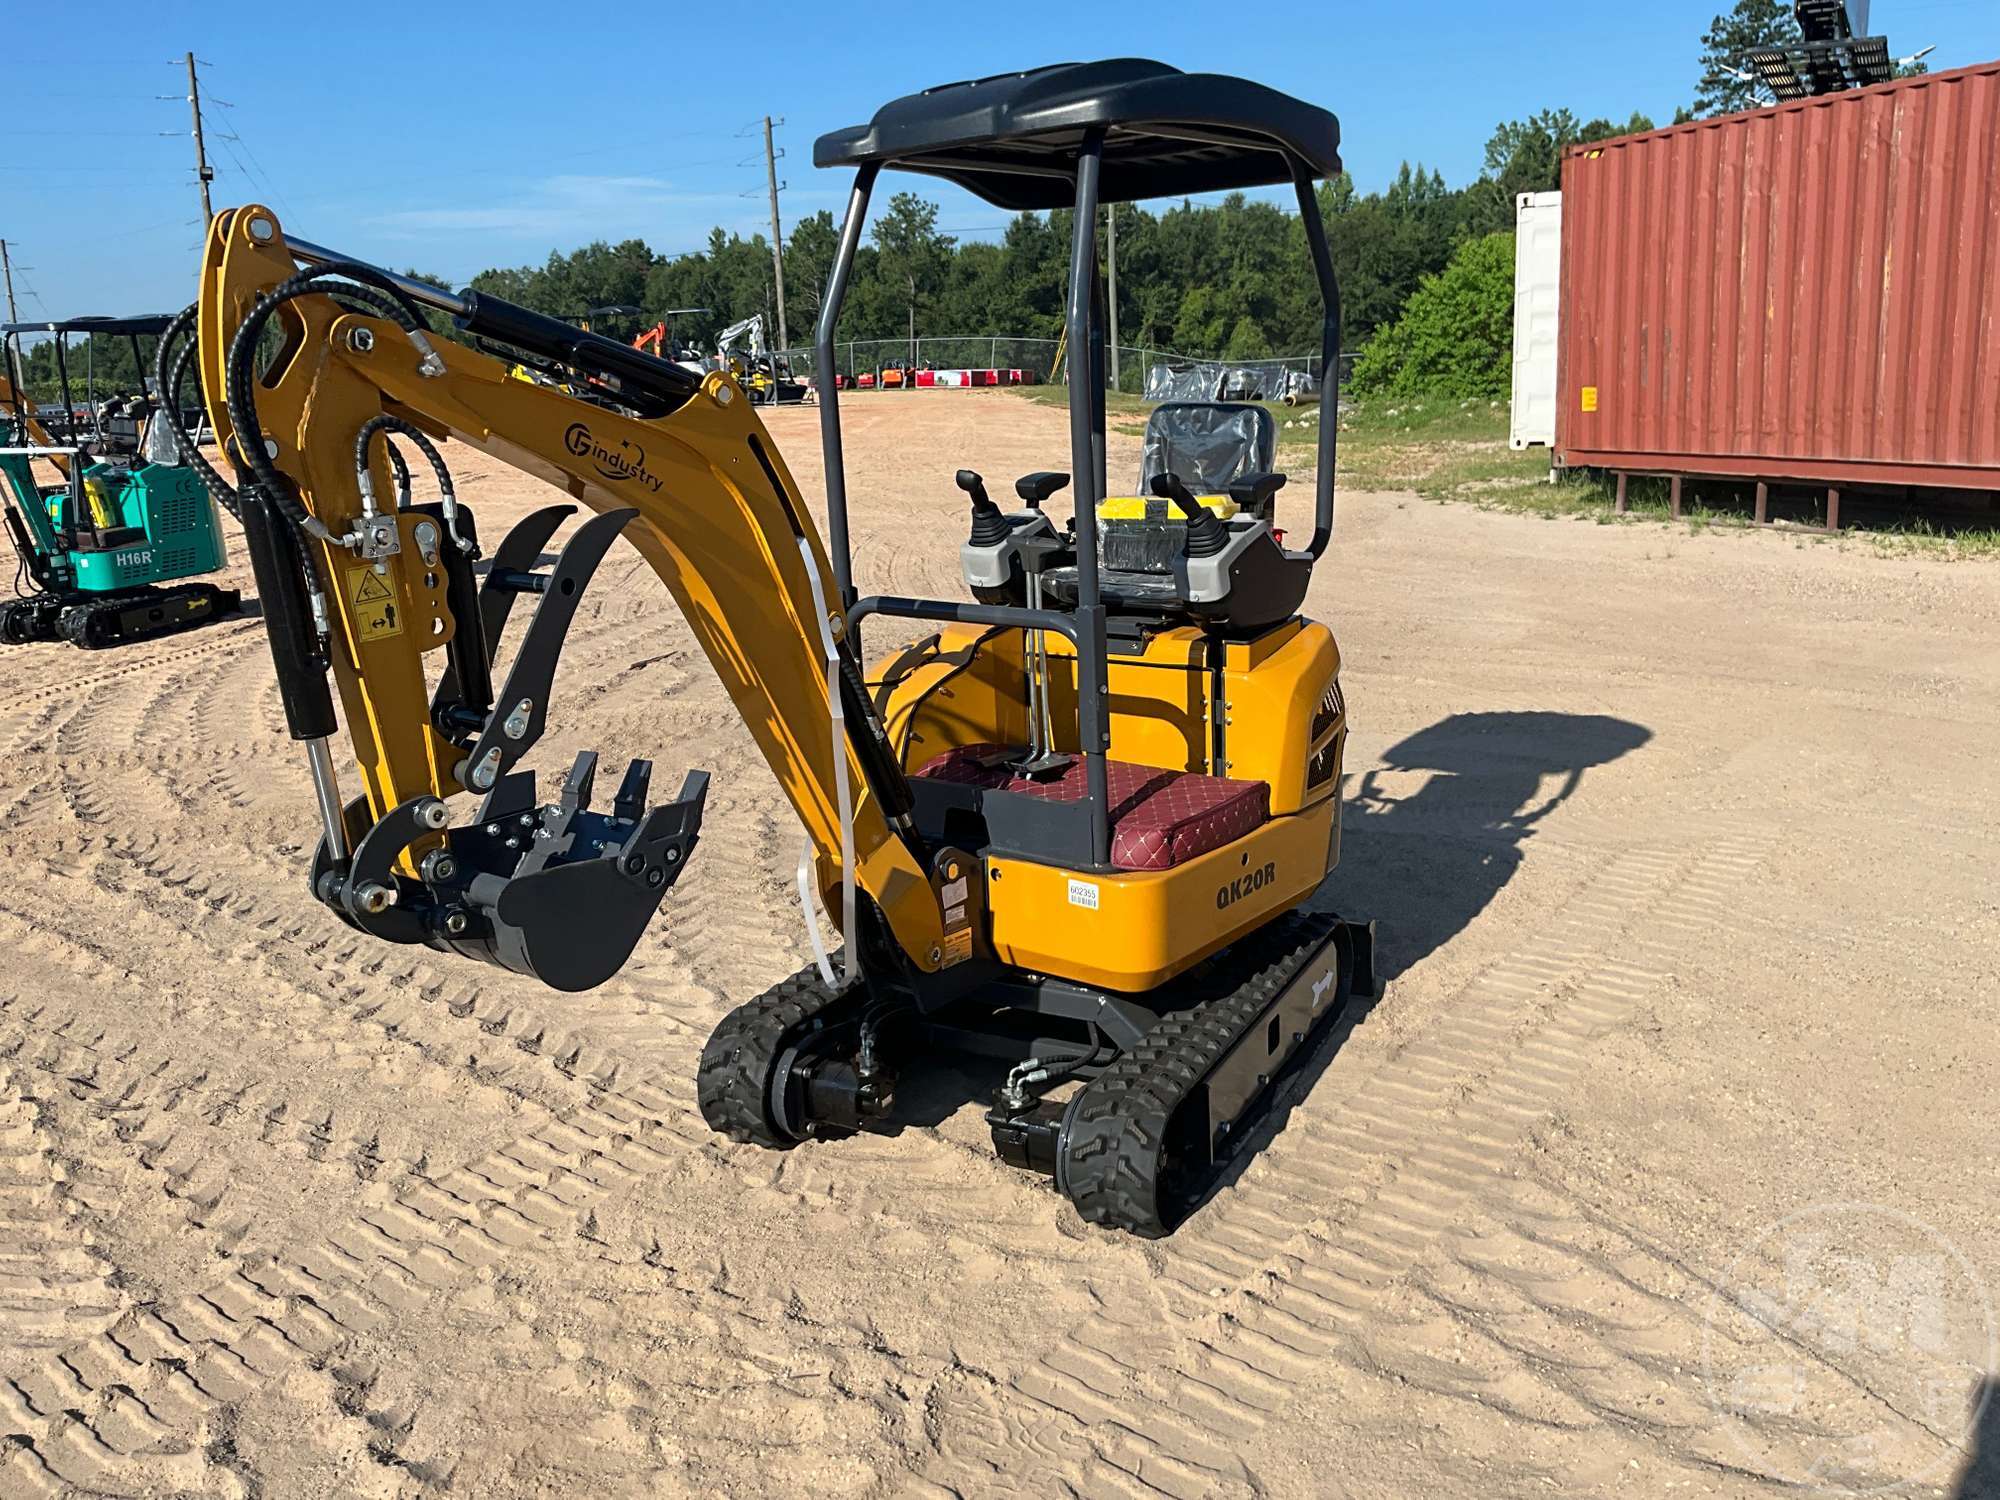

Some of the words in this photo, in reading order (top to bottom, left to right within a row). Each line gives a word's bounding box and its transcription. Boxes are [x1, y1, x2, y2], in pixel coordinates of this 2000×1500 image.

[116, 551, 152, 566] H16R
[1070, 885, 1096, 899] 602355
[1216, 862, 1275, 910] QK20R
